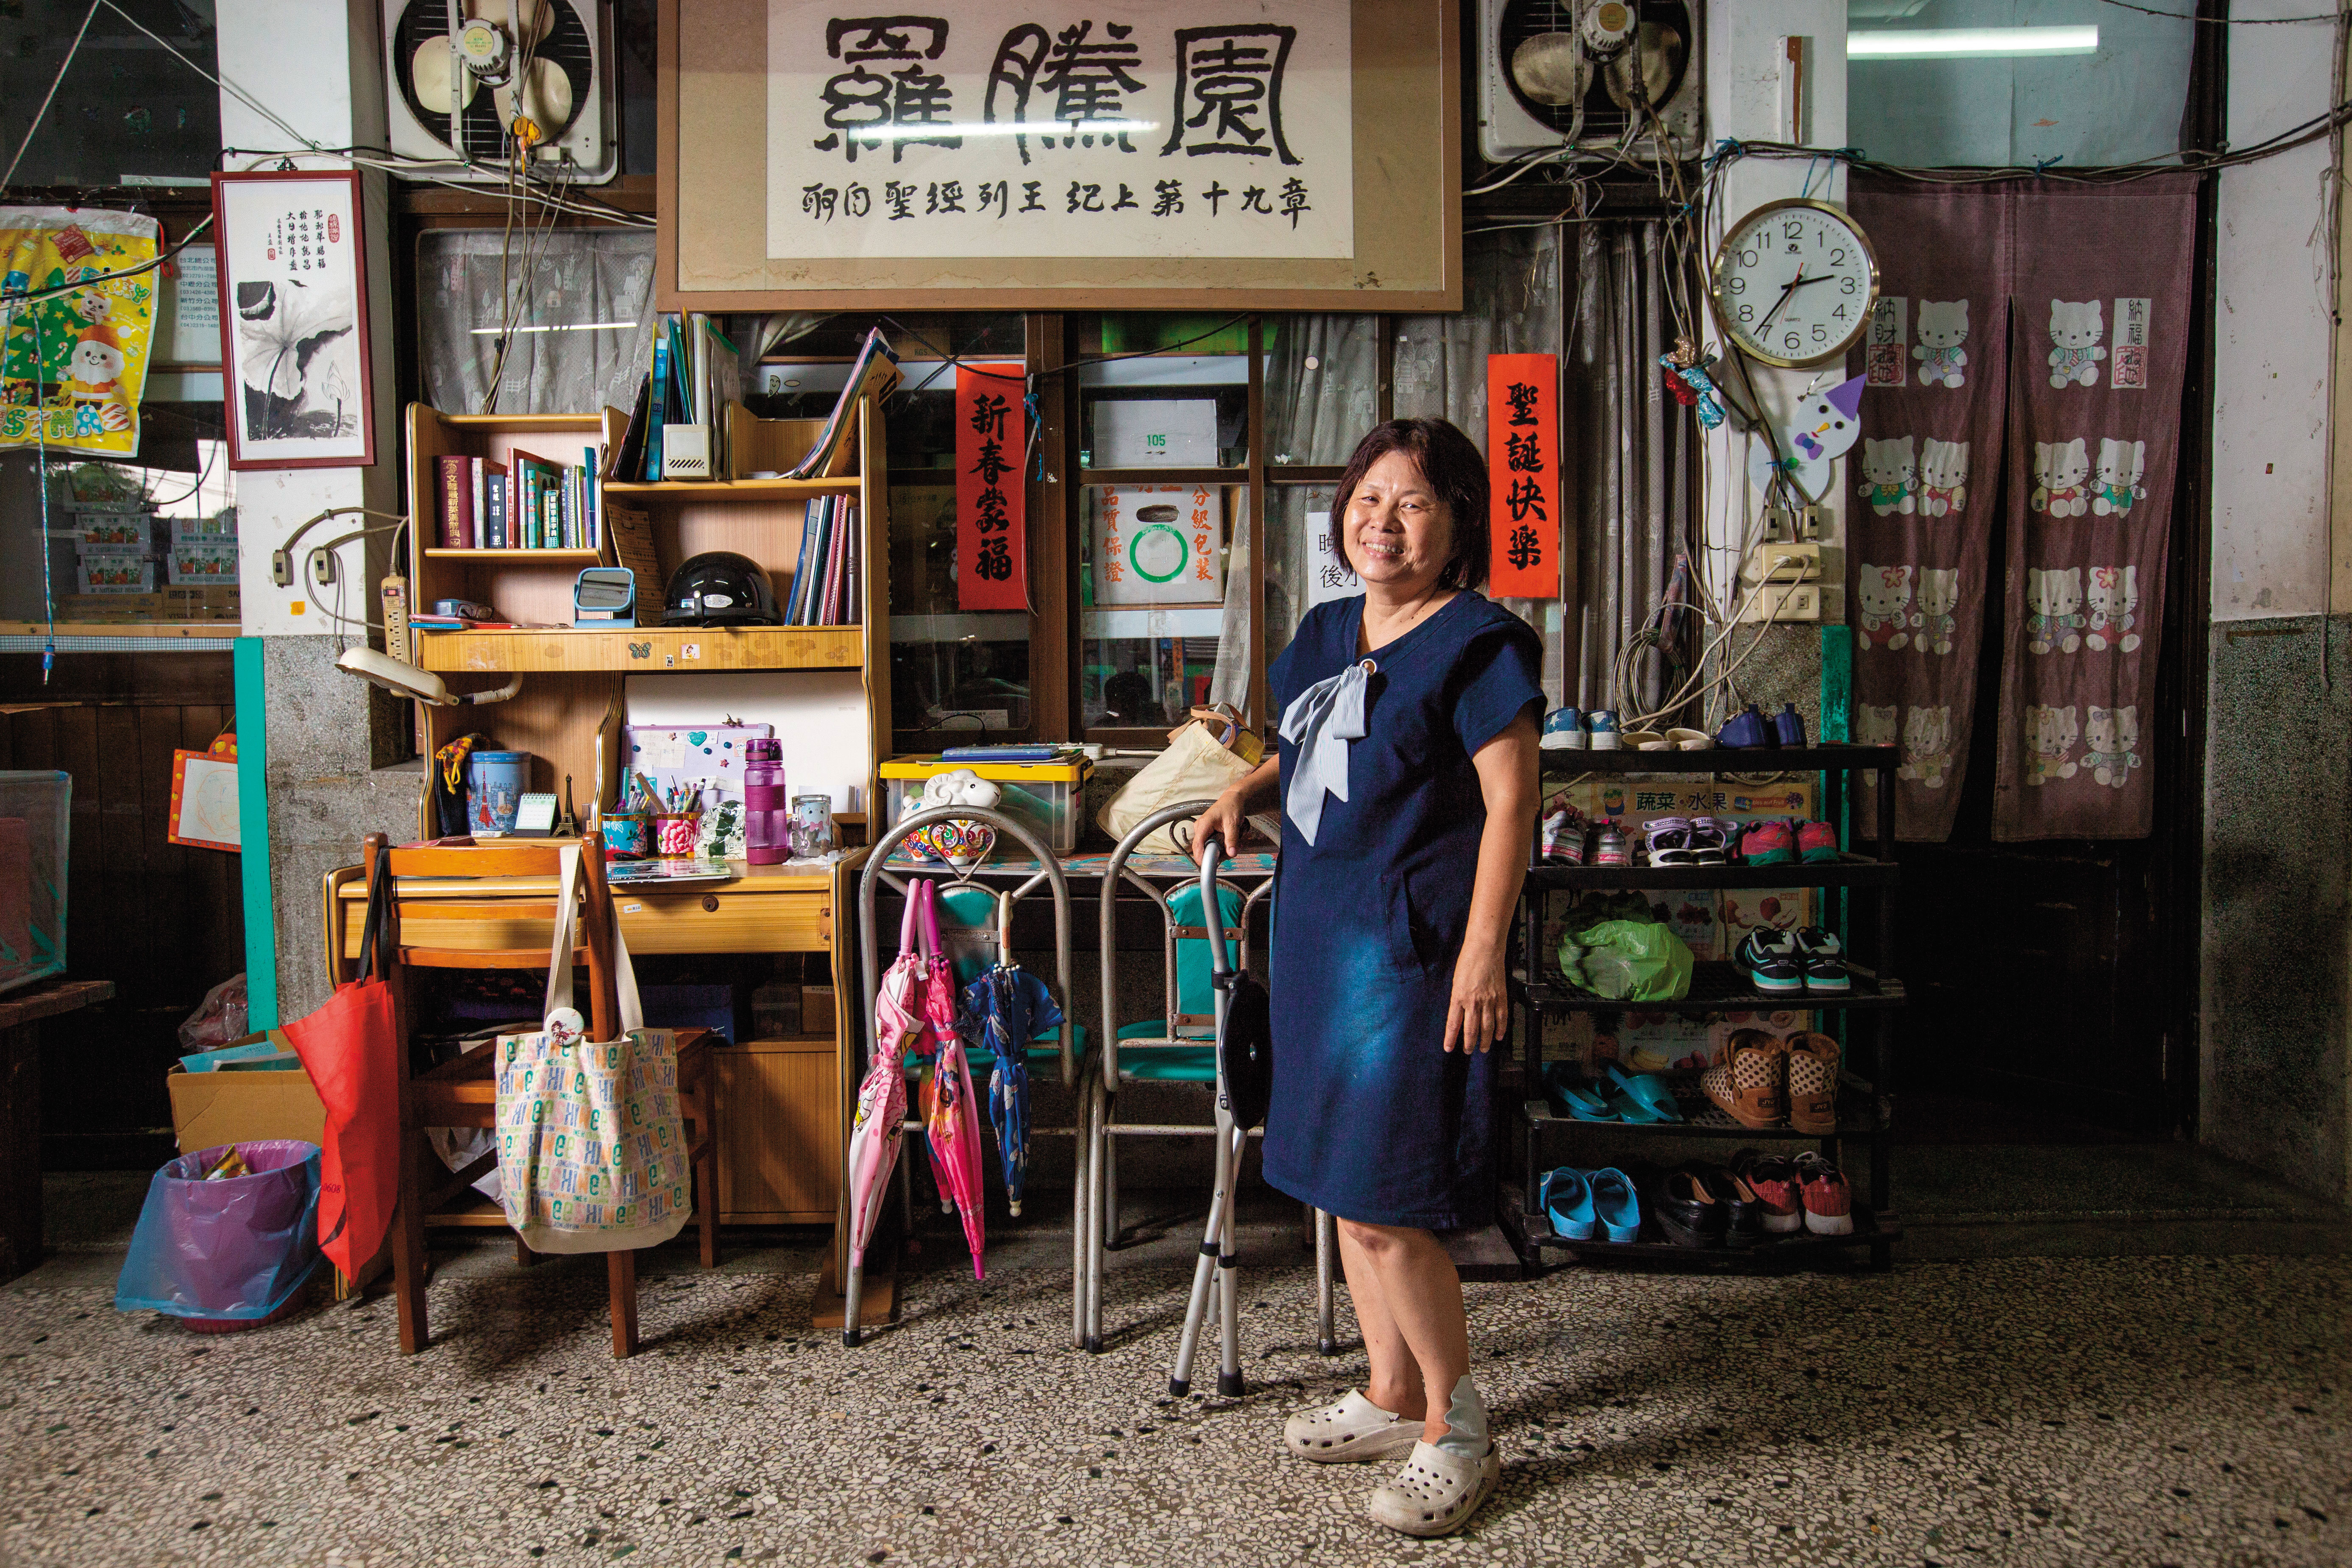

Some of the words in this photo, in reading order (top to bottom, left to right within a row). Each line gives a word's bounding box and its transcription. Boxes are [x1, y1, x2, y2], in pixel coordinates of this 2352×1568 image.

[1782, 222, 1803, 240] 12
[1818, 231, 1823, 248] 1
[1756, 232, 1770, 249] 11
[1738, 250, 1758, 267] 10
[1830, 249, 1845, 266] 2
[1729, 277, 1745, 294] 9
[1840, 277, 1855, 294] 3
[1739, 305, 1754, 322] 8
[1832, 304, 1846, 320] 4
[1784, 331, 1800, 349] 6
[1812, 324, 1827, 342] 5
[1147, 434, 1166, 447] 105
[1506, 383, 1546, 570] 聖誕快樂
[1191, 485, 1215, 582] 分級包裝
